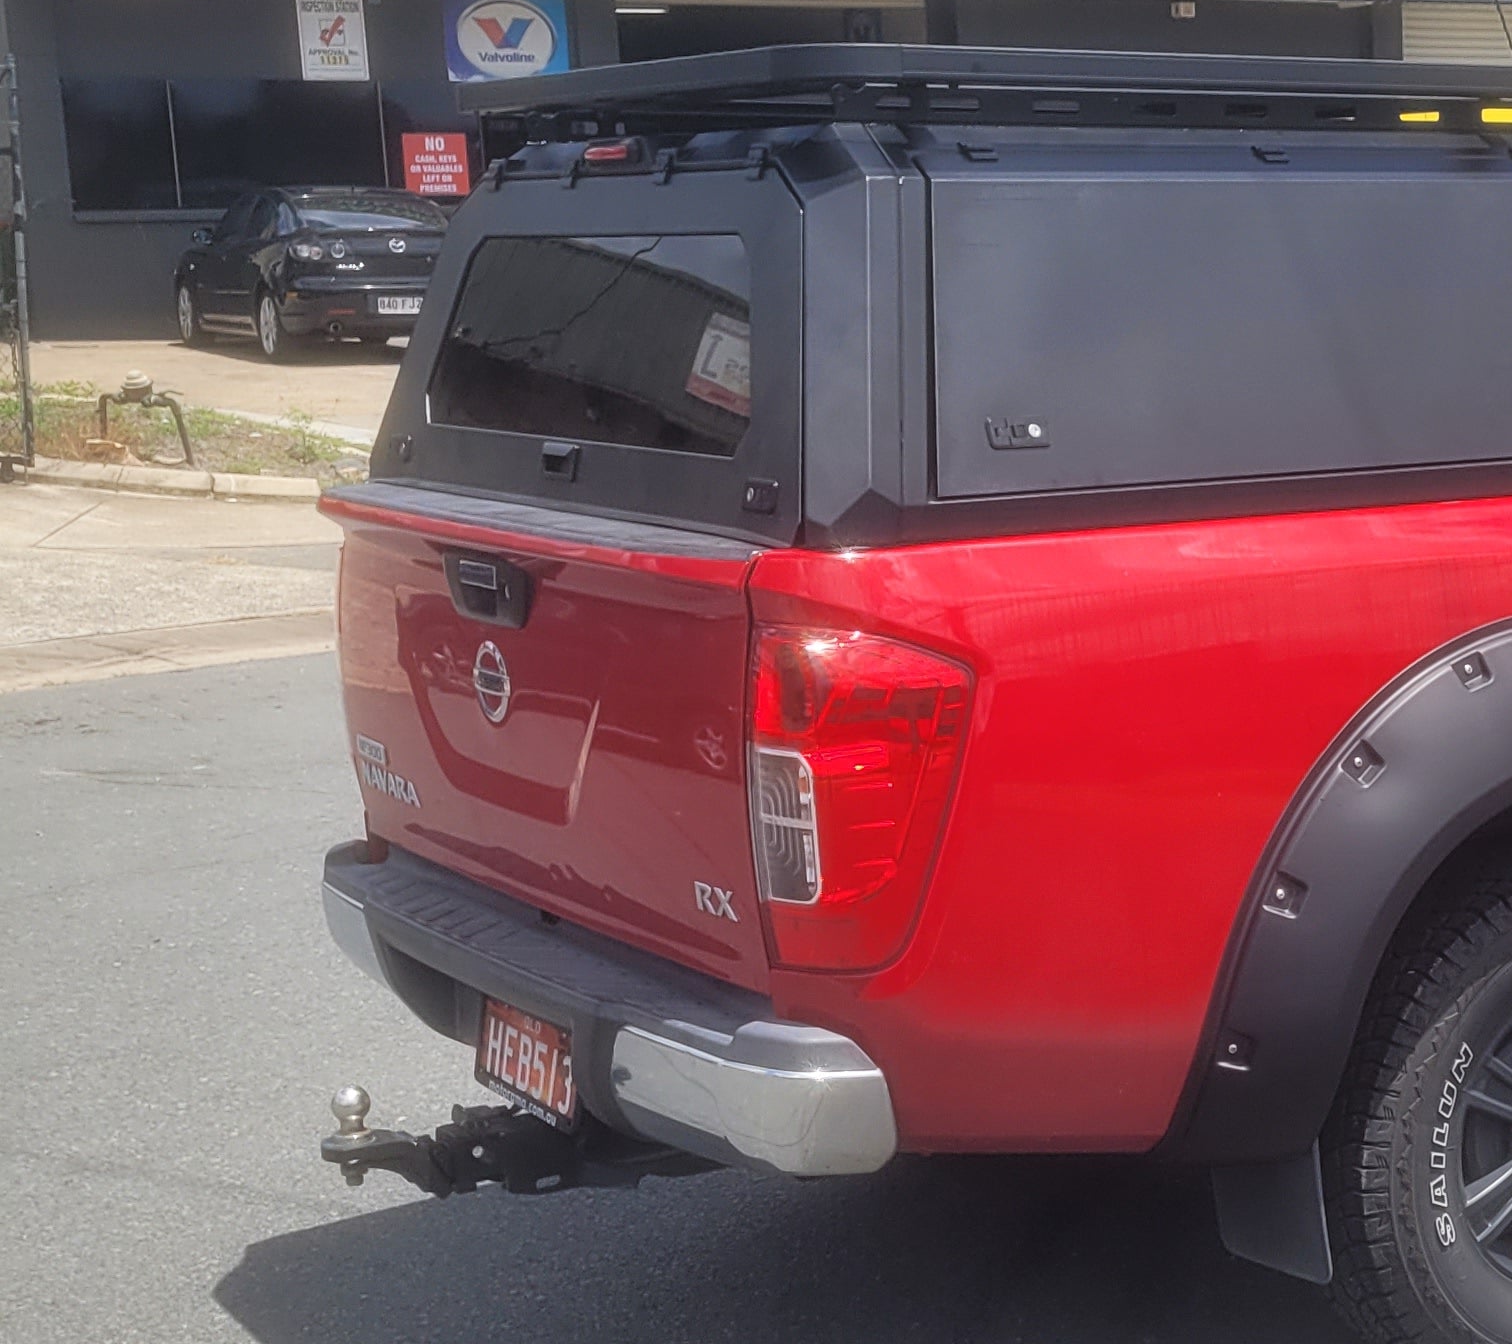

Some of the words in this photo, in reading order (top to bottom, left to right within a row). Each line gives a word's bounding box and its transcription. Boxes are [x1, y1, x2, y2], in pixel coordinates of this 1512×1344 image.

[308, 47, 346, 56] APPROVAL
[478, 51, 536, 64] Valvoline
[424, 136, 446, 152] NO
[438, 154, 457, 164] KEYS
[422, 164, 463, 174] VALUABLES
[422, 174, 440, 184] LEFT
[419, 183, 457, 194] PREMISES
[362, 759, 422, 809] NAVARA
[694, 880, 738, 923] RX
[486, 1016, 574, 1116] HEB513
[1429, 1041, 1474, 1247] SAILUN
